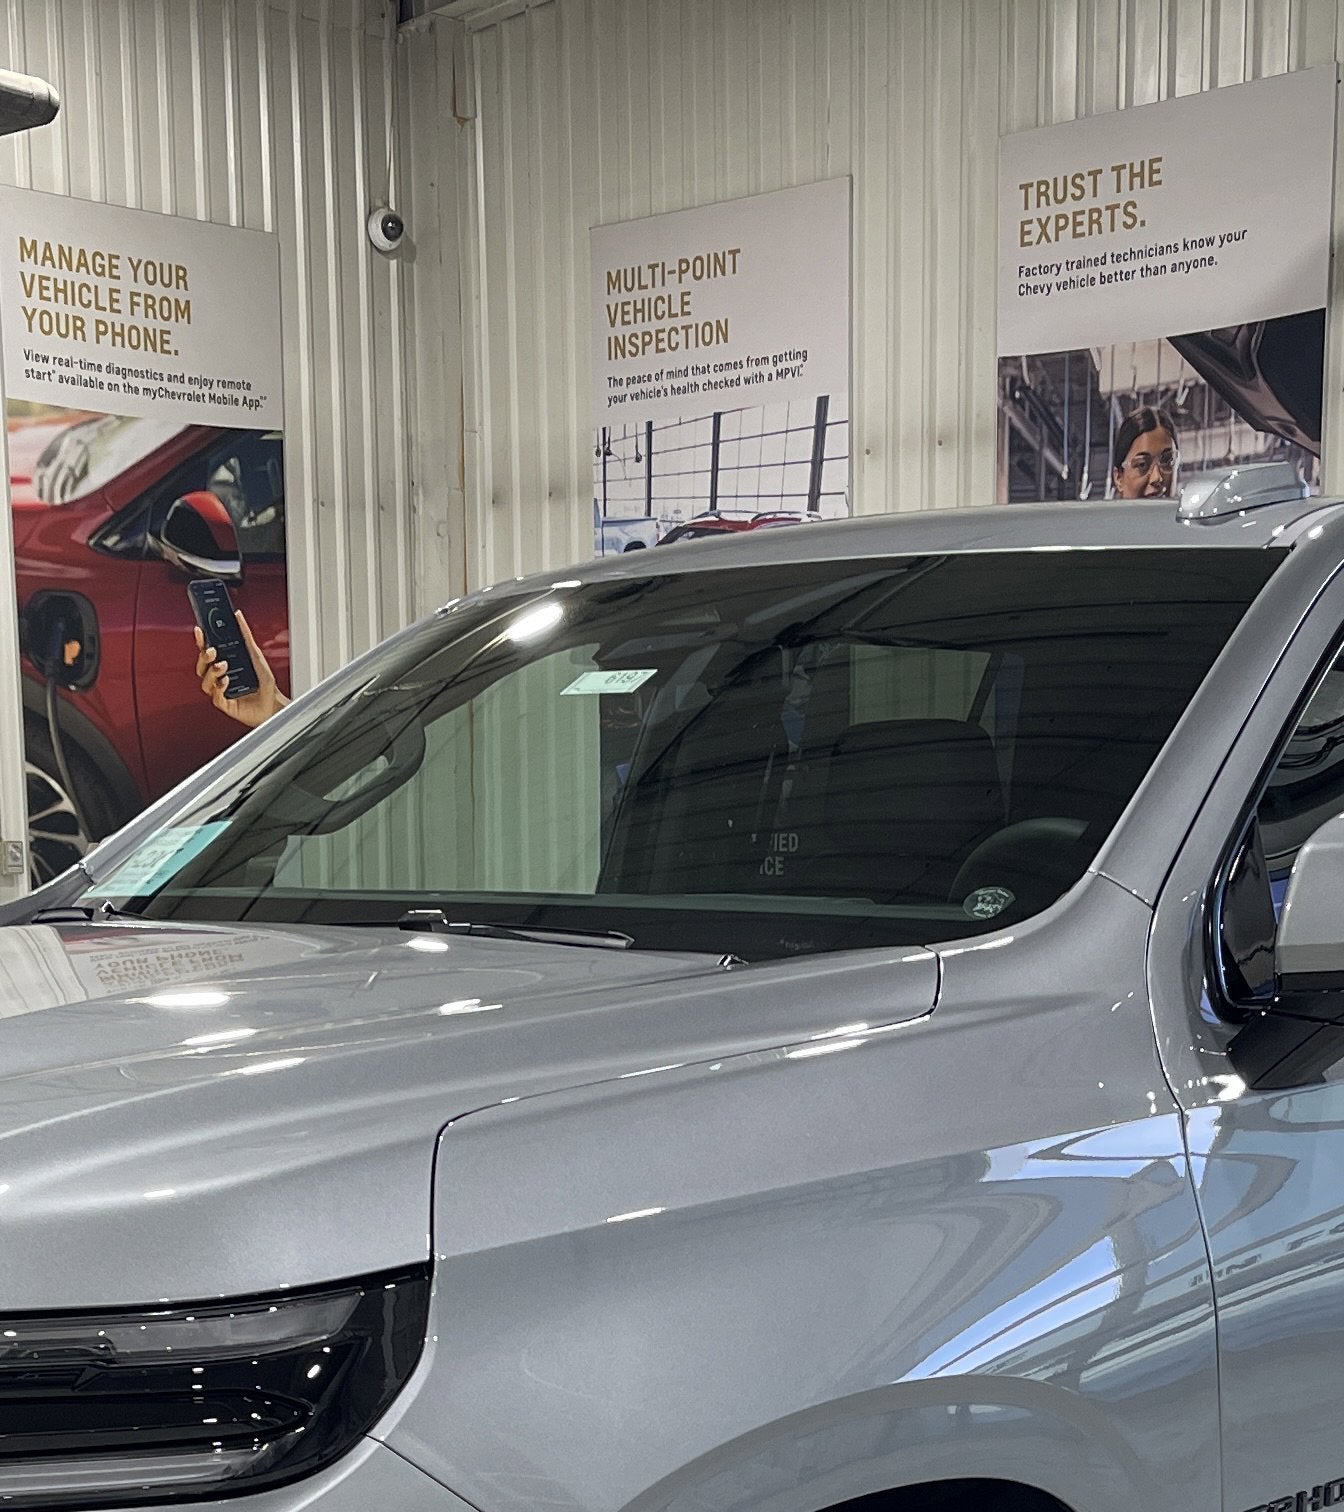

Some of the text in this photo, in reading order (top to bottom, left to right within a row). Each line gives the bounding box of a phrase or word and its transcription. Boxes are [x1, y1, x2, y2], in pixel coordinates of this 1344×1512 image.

[1019, 156, 1163, 211] TRUST THE
[1020, 200, 1146, 248] EXPERTS.
[19, 236, 189, 291] MANAGE YOUR
[606, 248, 741, 295] MULTI-POINT
[1018, 229, 1248, 279] Factory trained technicians know your
[1018, 255, 1218, 297] Chevy vehicle better than anyone.
[19, 271, 191, 325] VEHICLE FROM
[606, 290, 692, 328] VEHICLE
[21, 305, 179, 356] YOUR PHONE.
[607, 318, 729, 361] INSPECTION
[23, 348, 252, 391] View real-time diagnostics and enjoy remote
[58, 374, 104, 390] available
[107, 382, 120, 393] on
[123, 382, 140, 395] the
[142, 386, 206, 404] myChevrolet
[208, 393, 239, 407] Mobile
[607, 348, 807, 388] The peace of mind that comes from getting
[607, 393, 627, 408] your
[630, 386, 668, 402] vehicle's
[670, 381, 699, 396] health
[702, 374, 740, 392] checked
[744, 371, 765, 386] with
[767, 372, 773, 382] a
